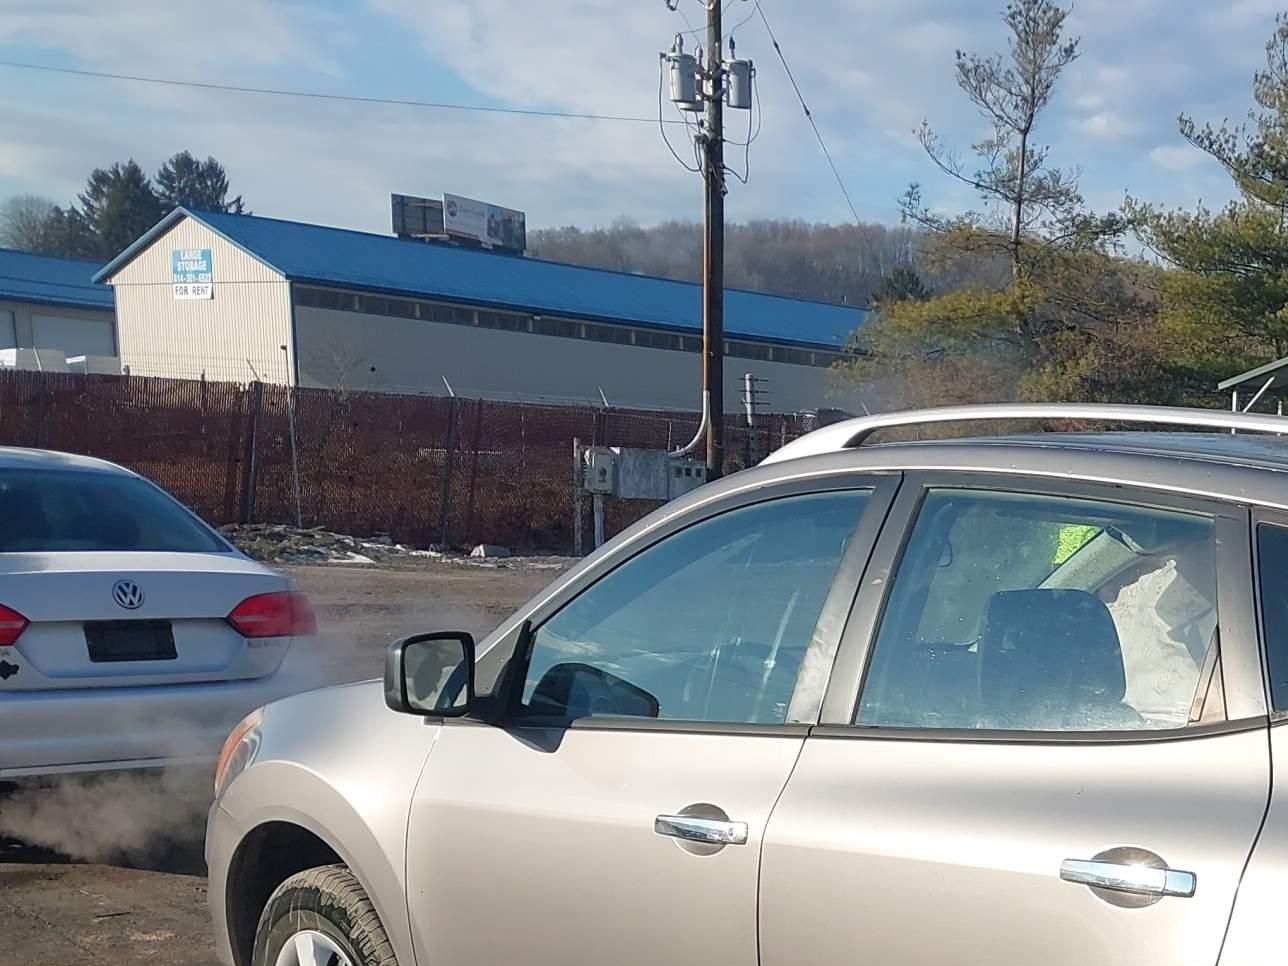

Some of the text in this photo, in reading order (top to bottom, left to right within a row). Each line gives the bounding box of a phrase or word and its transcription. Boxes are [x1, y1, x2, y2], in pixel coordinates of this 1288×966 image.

[177, 260, 207, 271] STORAGE
[175, 285, 209, 296] FOR RENT
